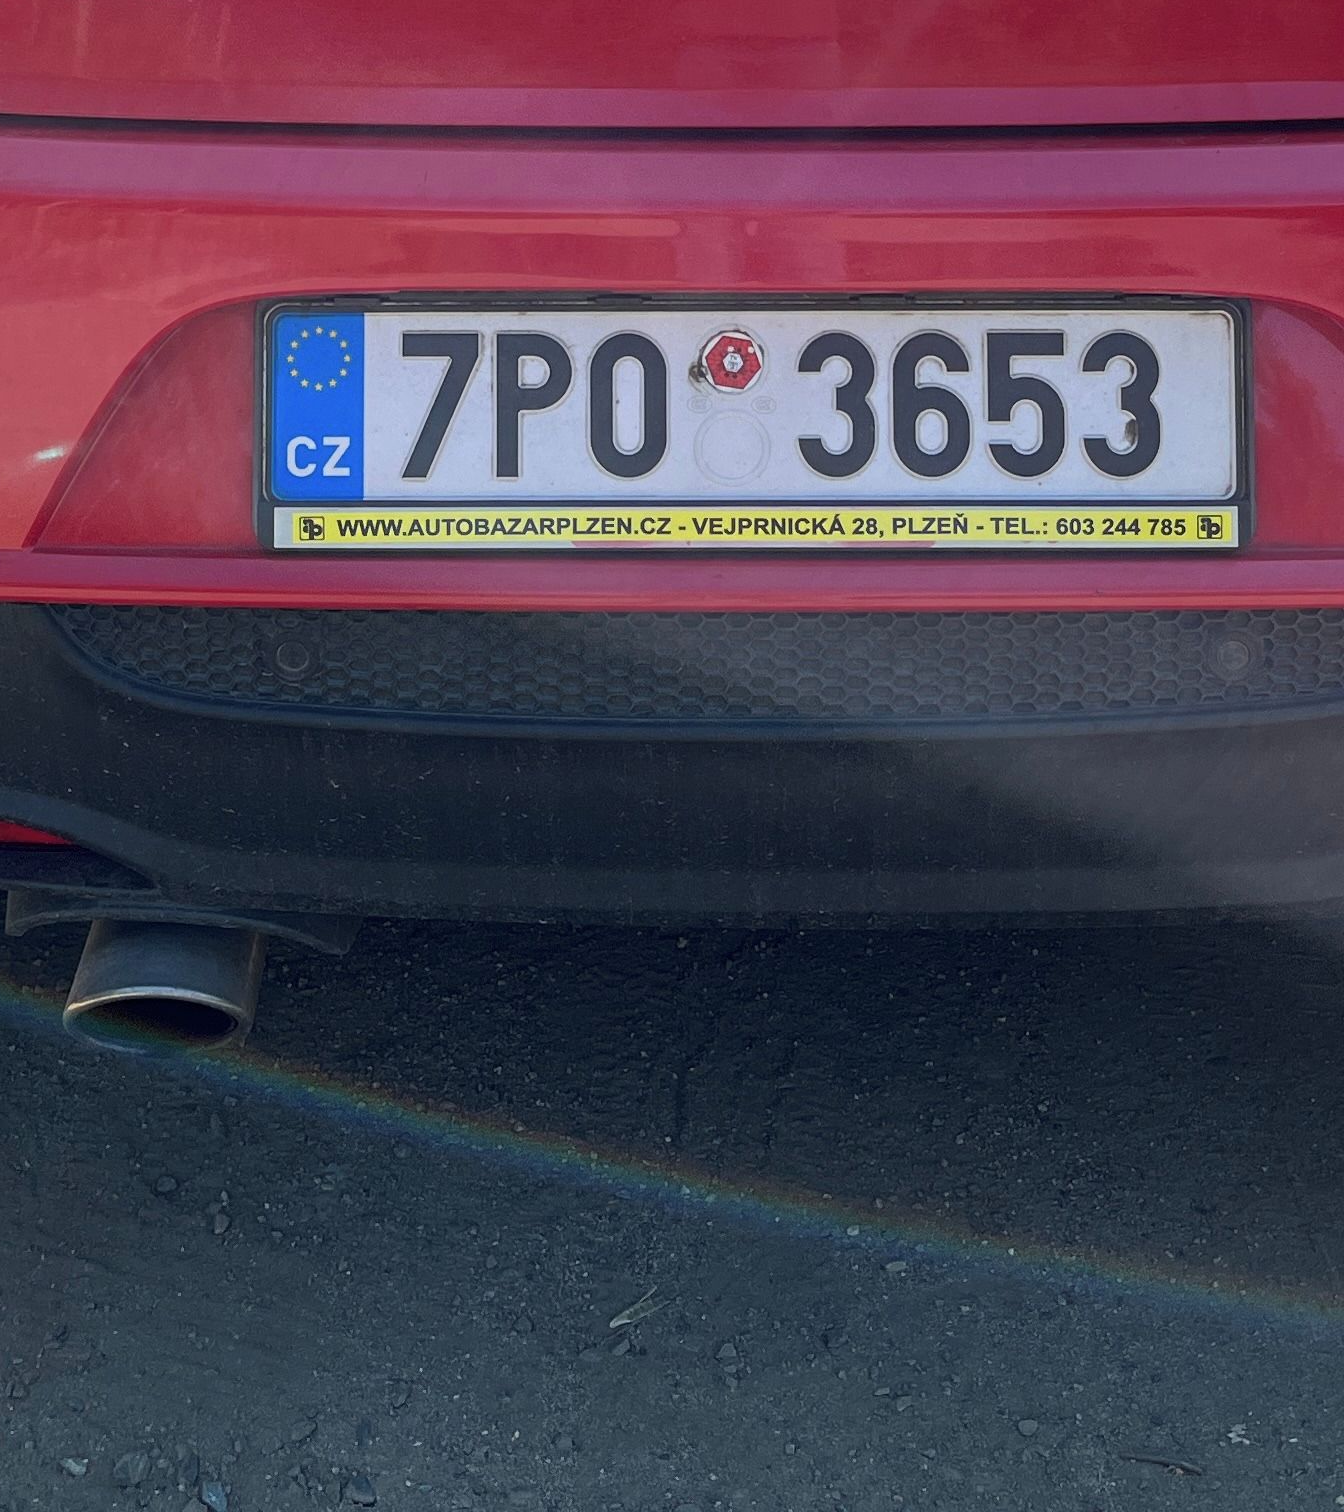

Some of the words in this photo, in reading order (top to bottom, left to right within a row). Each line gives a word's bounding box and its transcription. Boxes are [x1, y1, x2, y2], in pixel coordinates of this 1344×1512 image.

[402, 332, 668, 479] 7P0
[798, 332, 1161, 478] 3653
[286, 436, 351, 477] CZ
[337, 517, 671, 537] WWW.AUTOBAZARPLZEN.CZ
[692, 513, 844, 536] VEJPRNICKÁ
[851, 518, 884, 538] 28,
[892, 513, 968, 535] PLZEŇ
[992, 517, 1048, 535] TEL.:
[1056, 518, 1094, 535] 603
[1102, 518, 1141, 535] 244
[1148, 518, 1186, 535] 785
